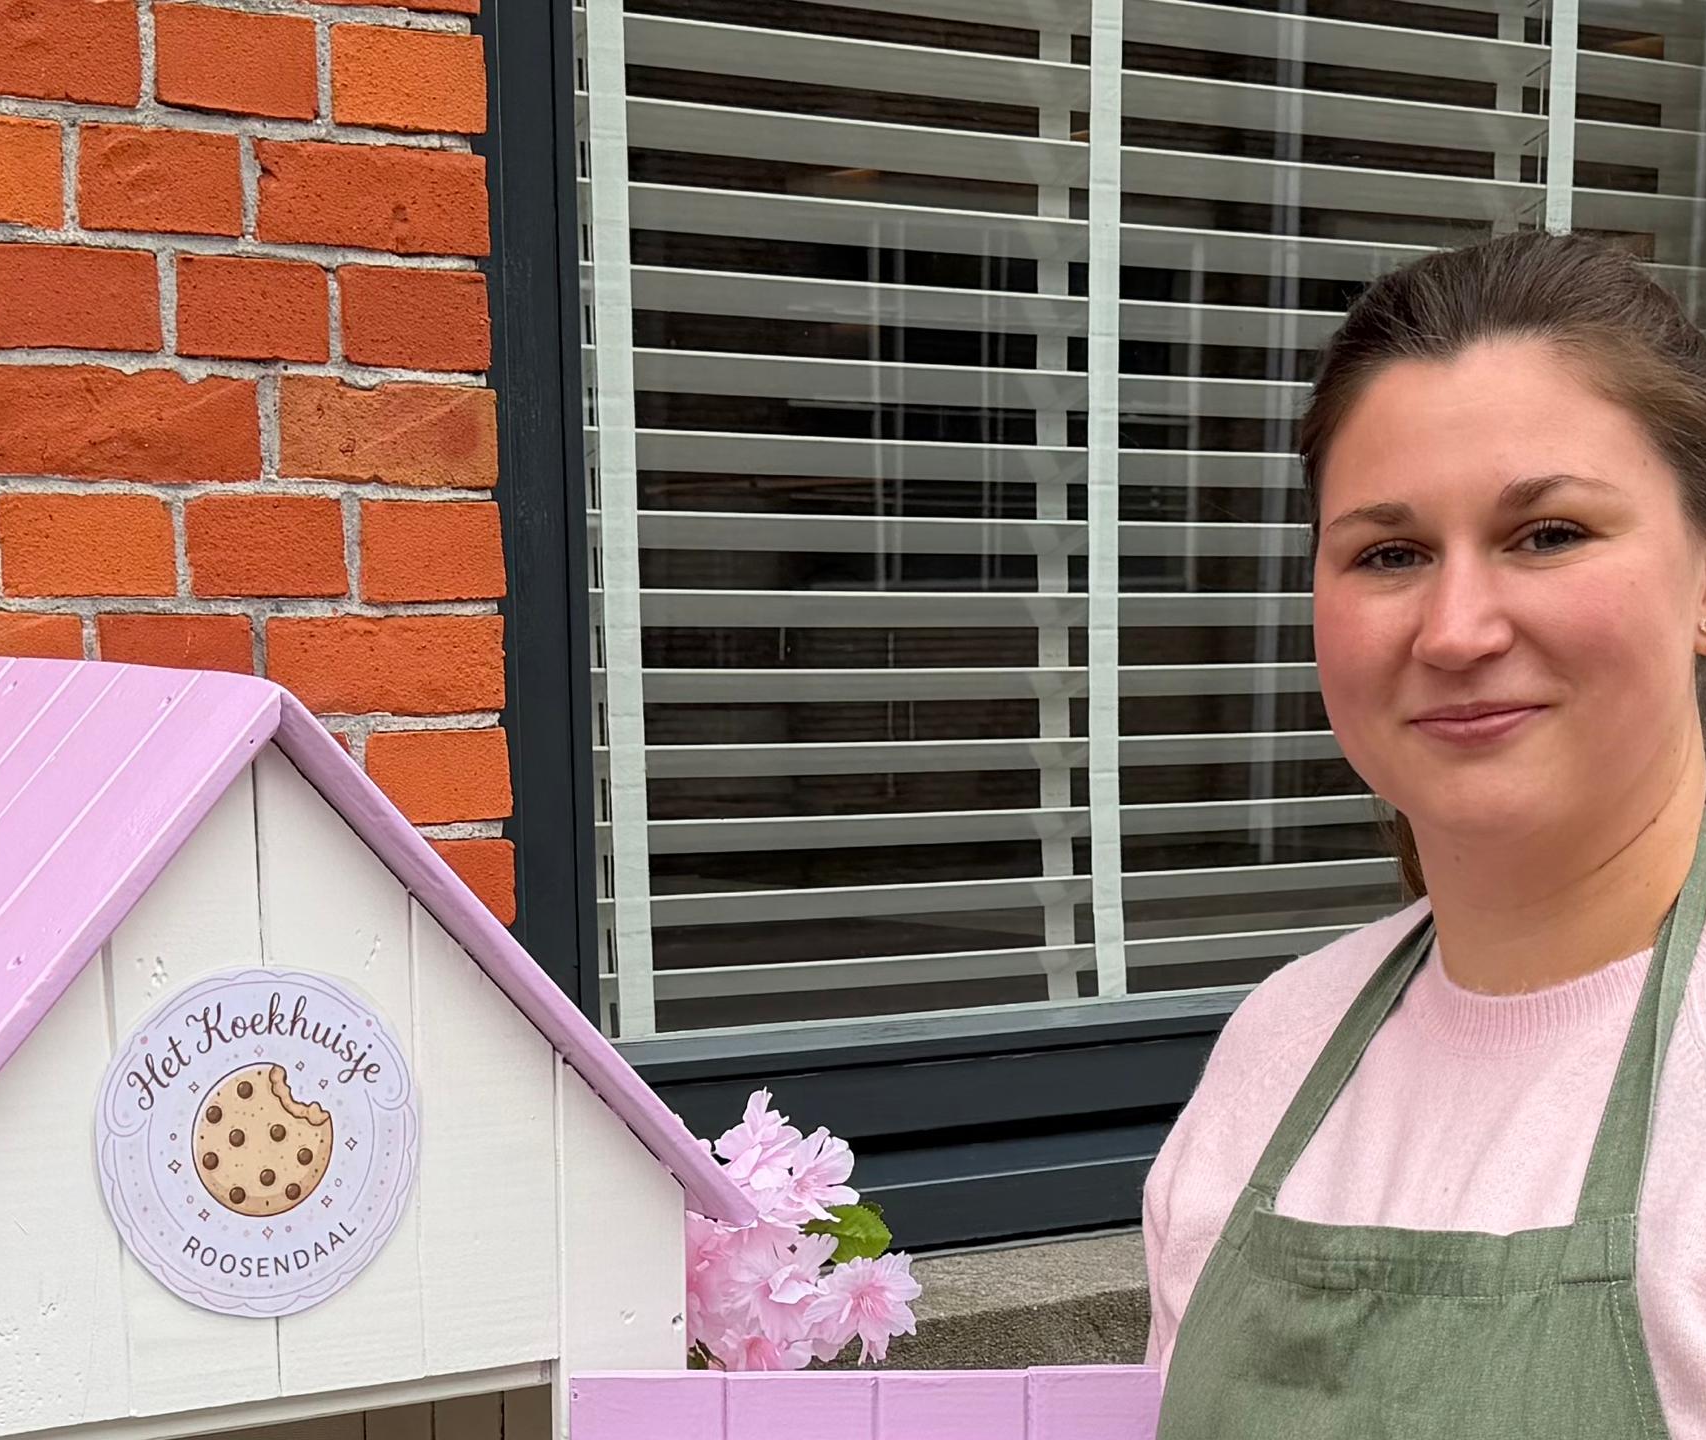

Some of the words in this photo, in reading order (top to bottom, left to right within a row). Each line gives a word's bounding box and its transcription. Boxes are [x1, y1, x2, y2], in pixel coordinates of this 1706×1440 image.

[127, 1036, 192, 1111] Het
[185, 992, 382, 1085] Koekhuisje
[182, 1221, 357, 1278] ROOSENDAAL
